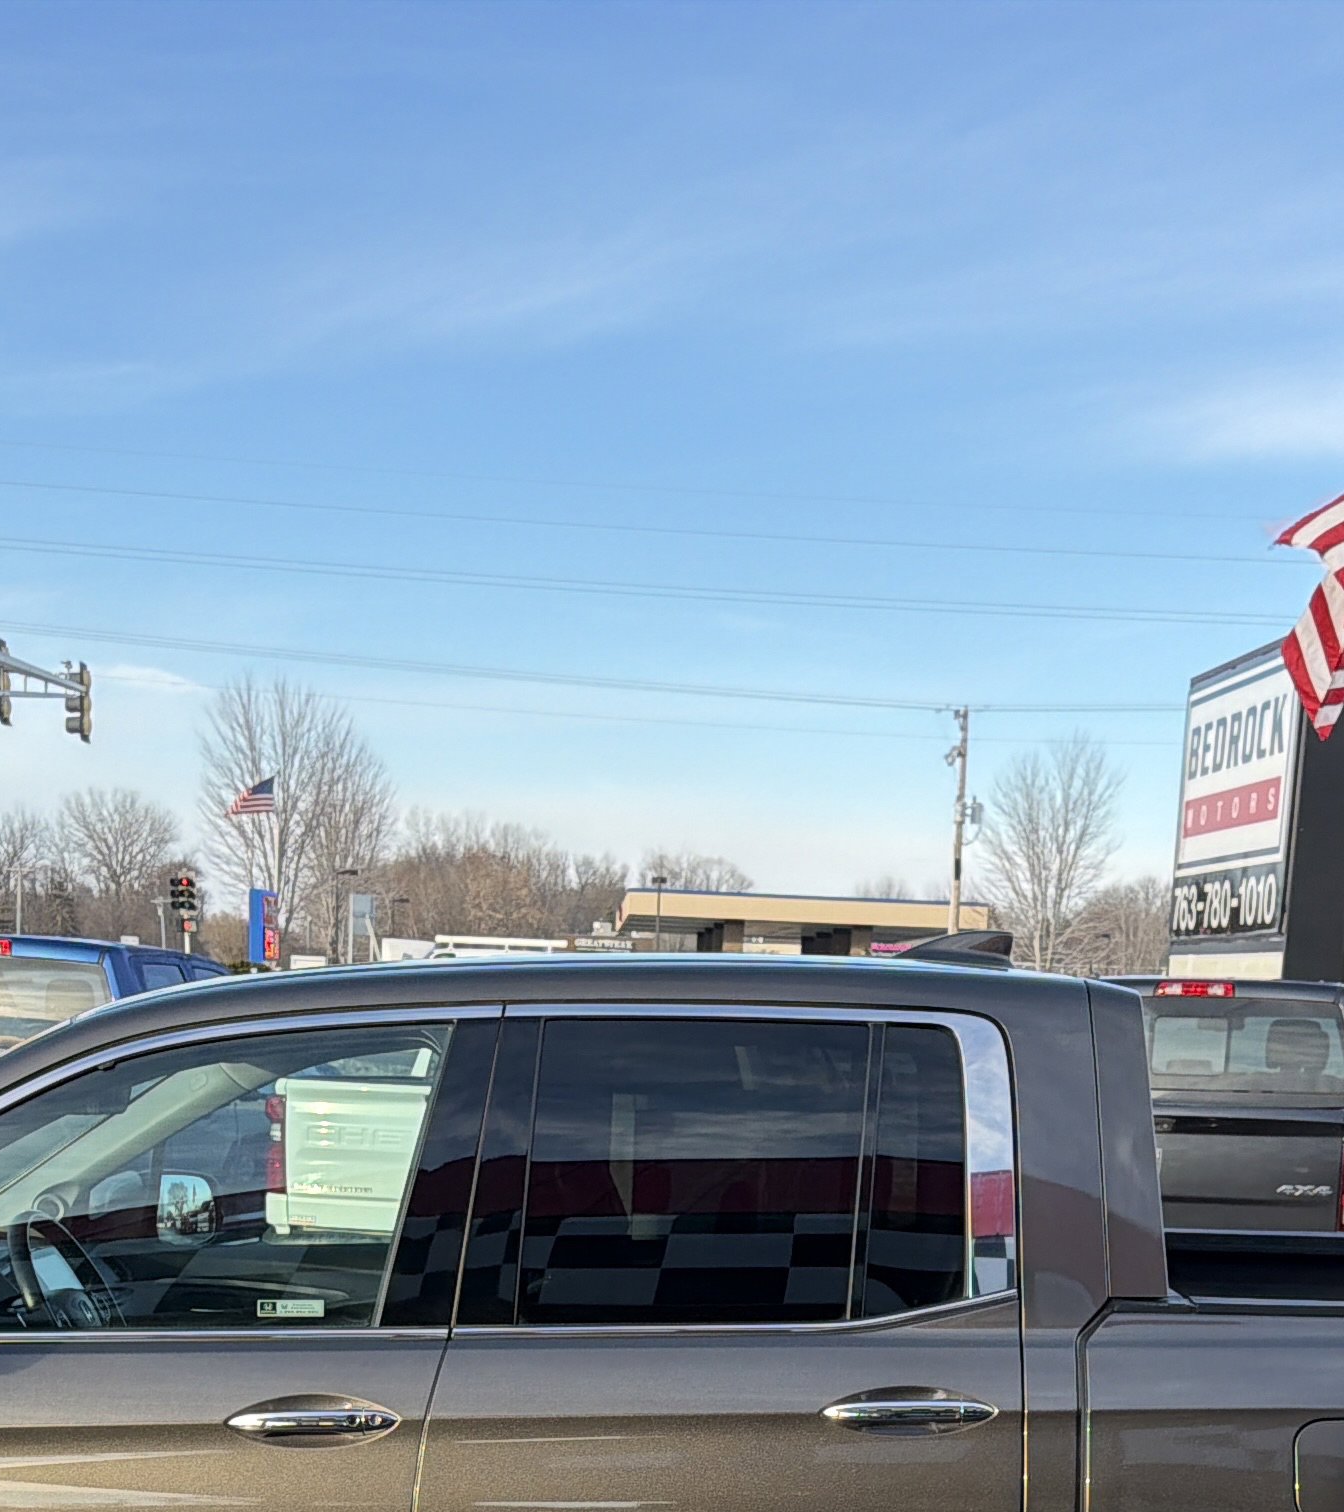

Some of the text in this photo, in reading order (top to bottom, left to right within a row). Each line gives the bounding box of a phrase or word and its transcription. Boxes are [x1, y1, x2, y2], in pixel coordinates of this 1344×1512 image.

[1188, 693, 1287, 780] BEDROCK
[1186, 787, 1276, 828] MOTORS
[1173, 873, 1276, 931] 763-780-1010
